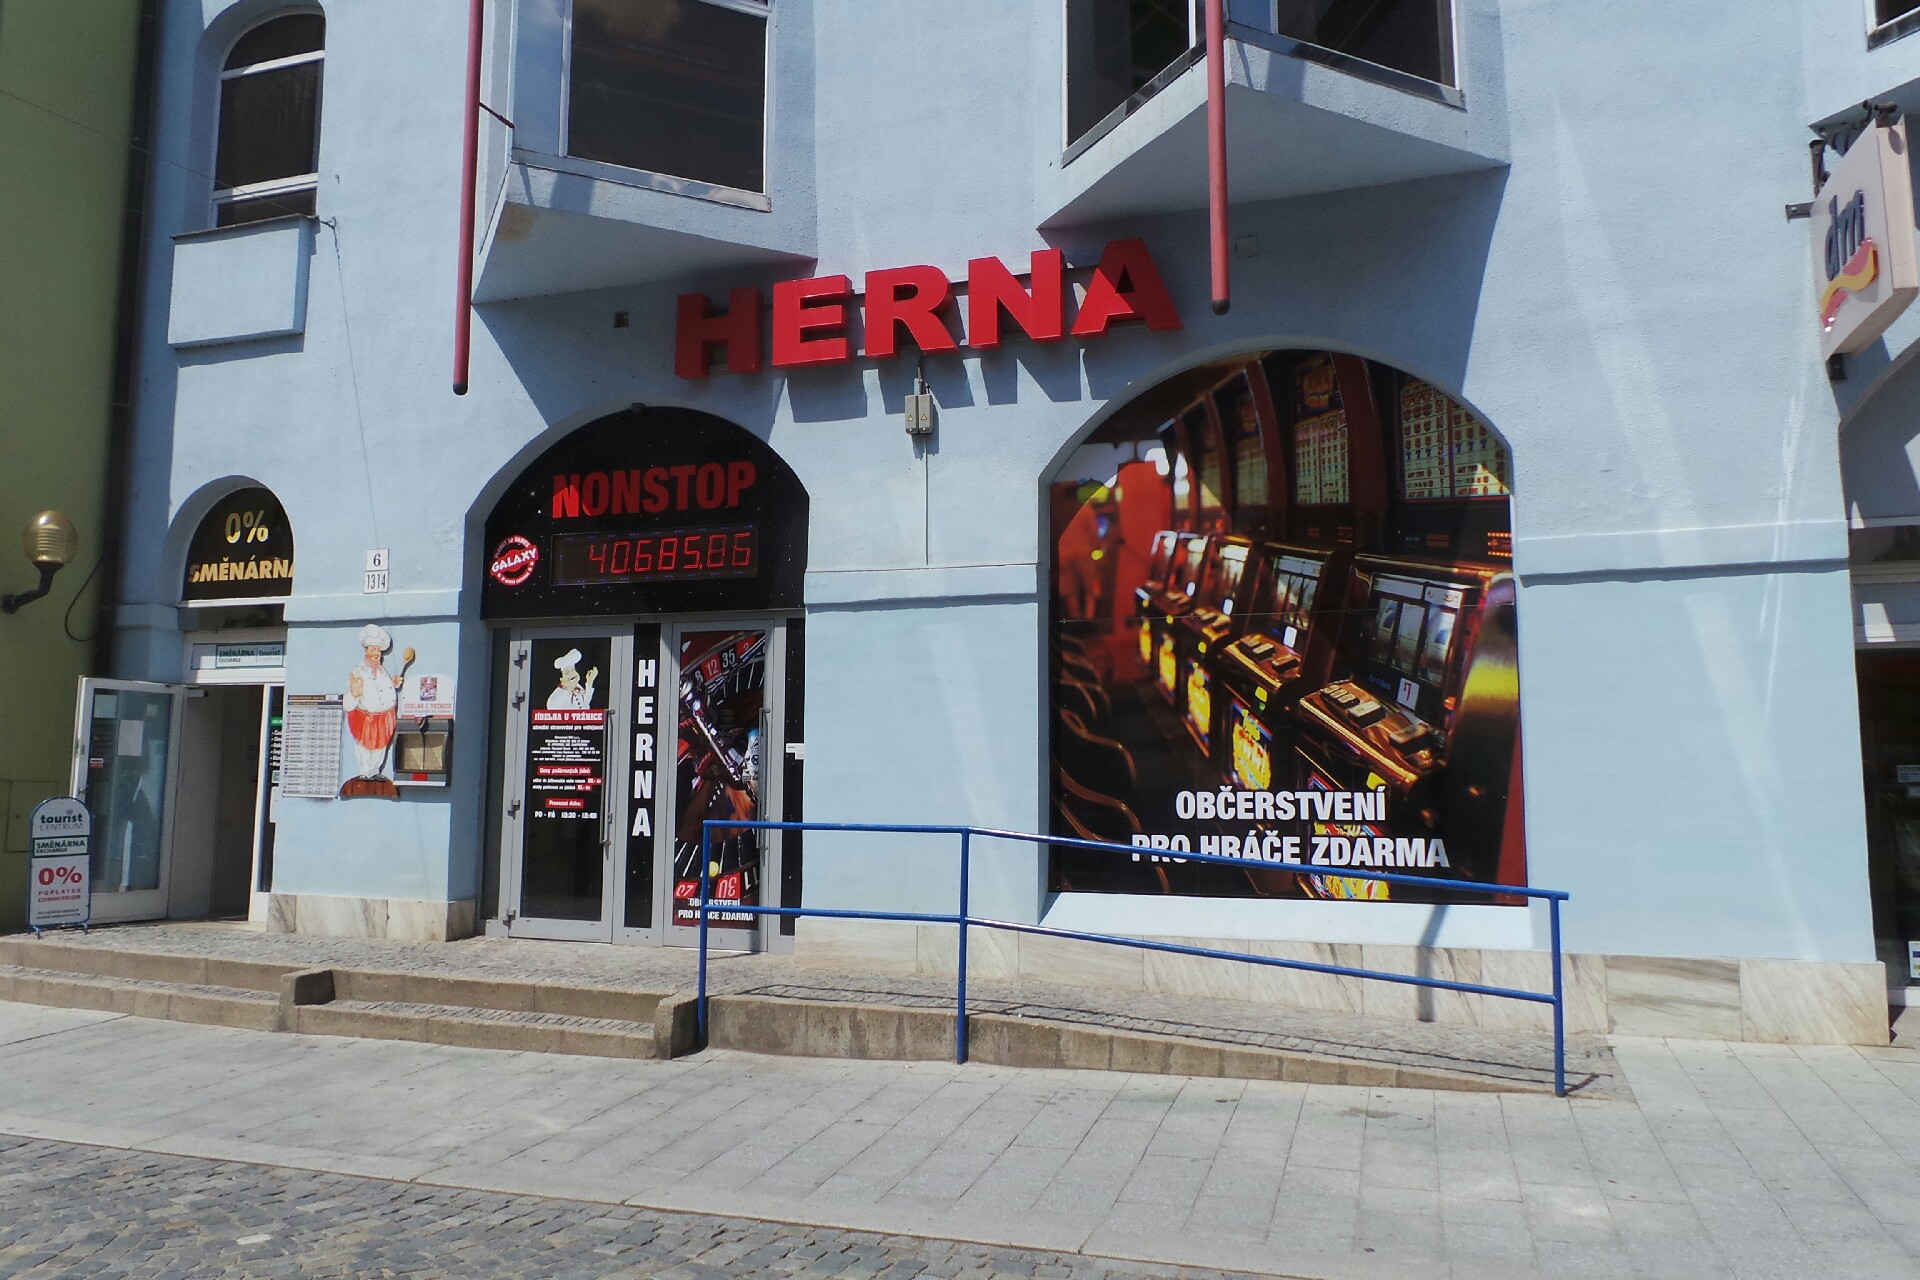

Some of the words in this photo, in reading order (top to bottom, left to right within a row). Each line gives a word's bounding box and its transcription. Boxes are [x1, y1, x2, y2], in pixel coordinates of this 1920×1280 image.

[674, 237, 1184, 380] HERNA
[552, 461, 757, 519] NONSTOP
[225, 510, 269, 544] 0%
[373, 553, 381, 567] 6
[491, 548, 536, 572] GALAXY
[367, 573, 386, 590] 1314
[706, 659, 719, 677] 12
[722, 648, 736, 669] 35
[534, 711, 562, 721] JÍDELNA
[564, 713, 569, 721] U
[571, 711, 603, 721] TRŽNICE
[631, 659, 656, 837] HERNA
[1175, 784, 1386, 821] OBČERSTVENÍ
[40, 811, 83, 824] tourist
[36, 840, 86, 849] SMĚNÁRNA
[1131, 834, 1191, 863] PRO
[1200, 829, 1301, 864] HRÁČE
[1311, 836, 1450, 868] ZDARMA
[38, 865, 83, 886] 0%
[678, 909, 693, 919] PRO
[721, 912, 754, 921] ZDARMA
